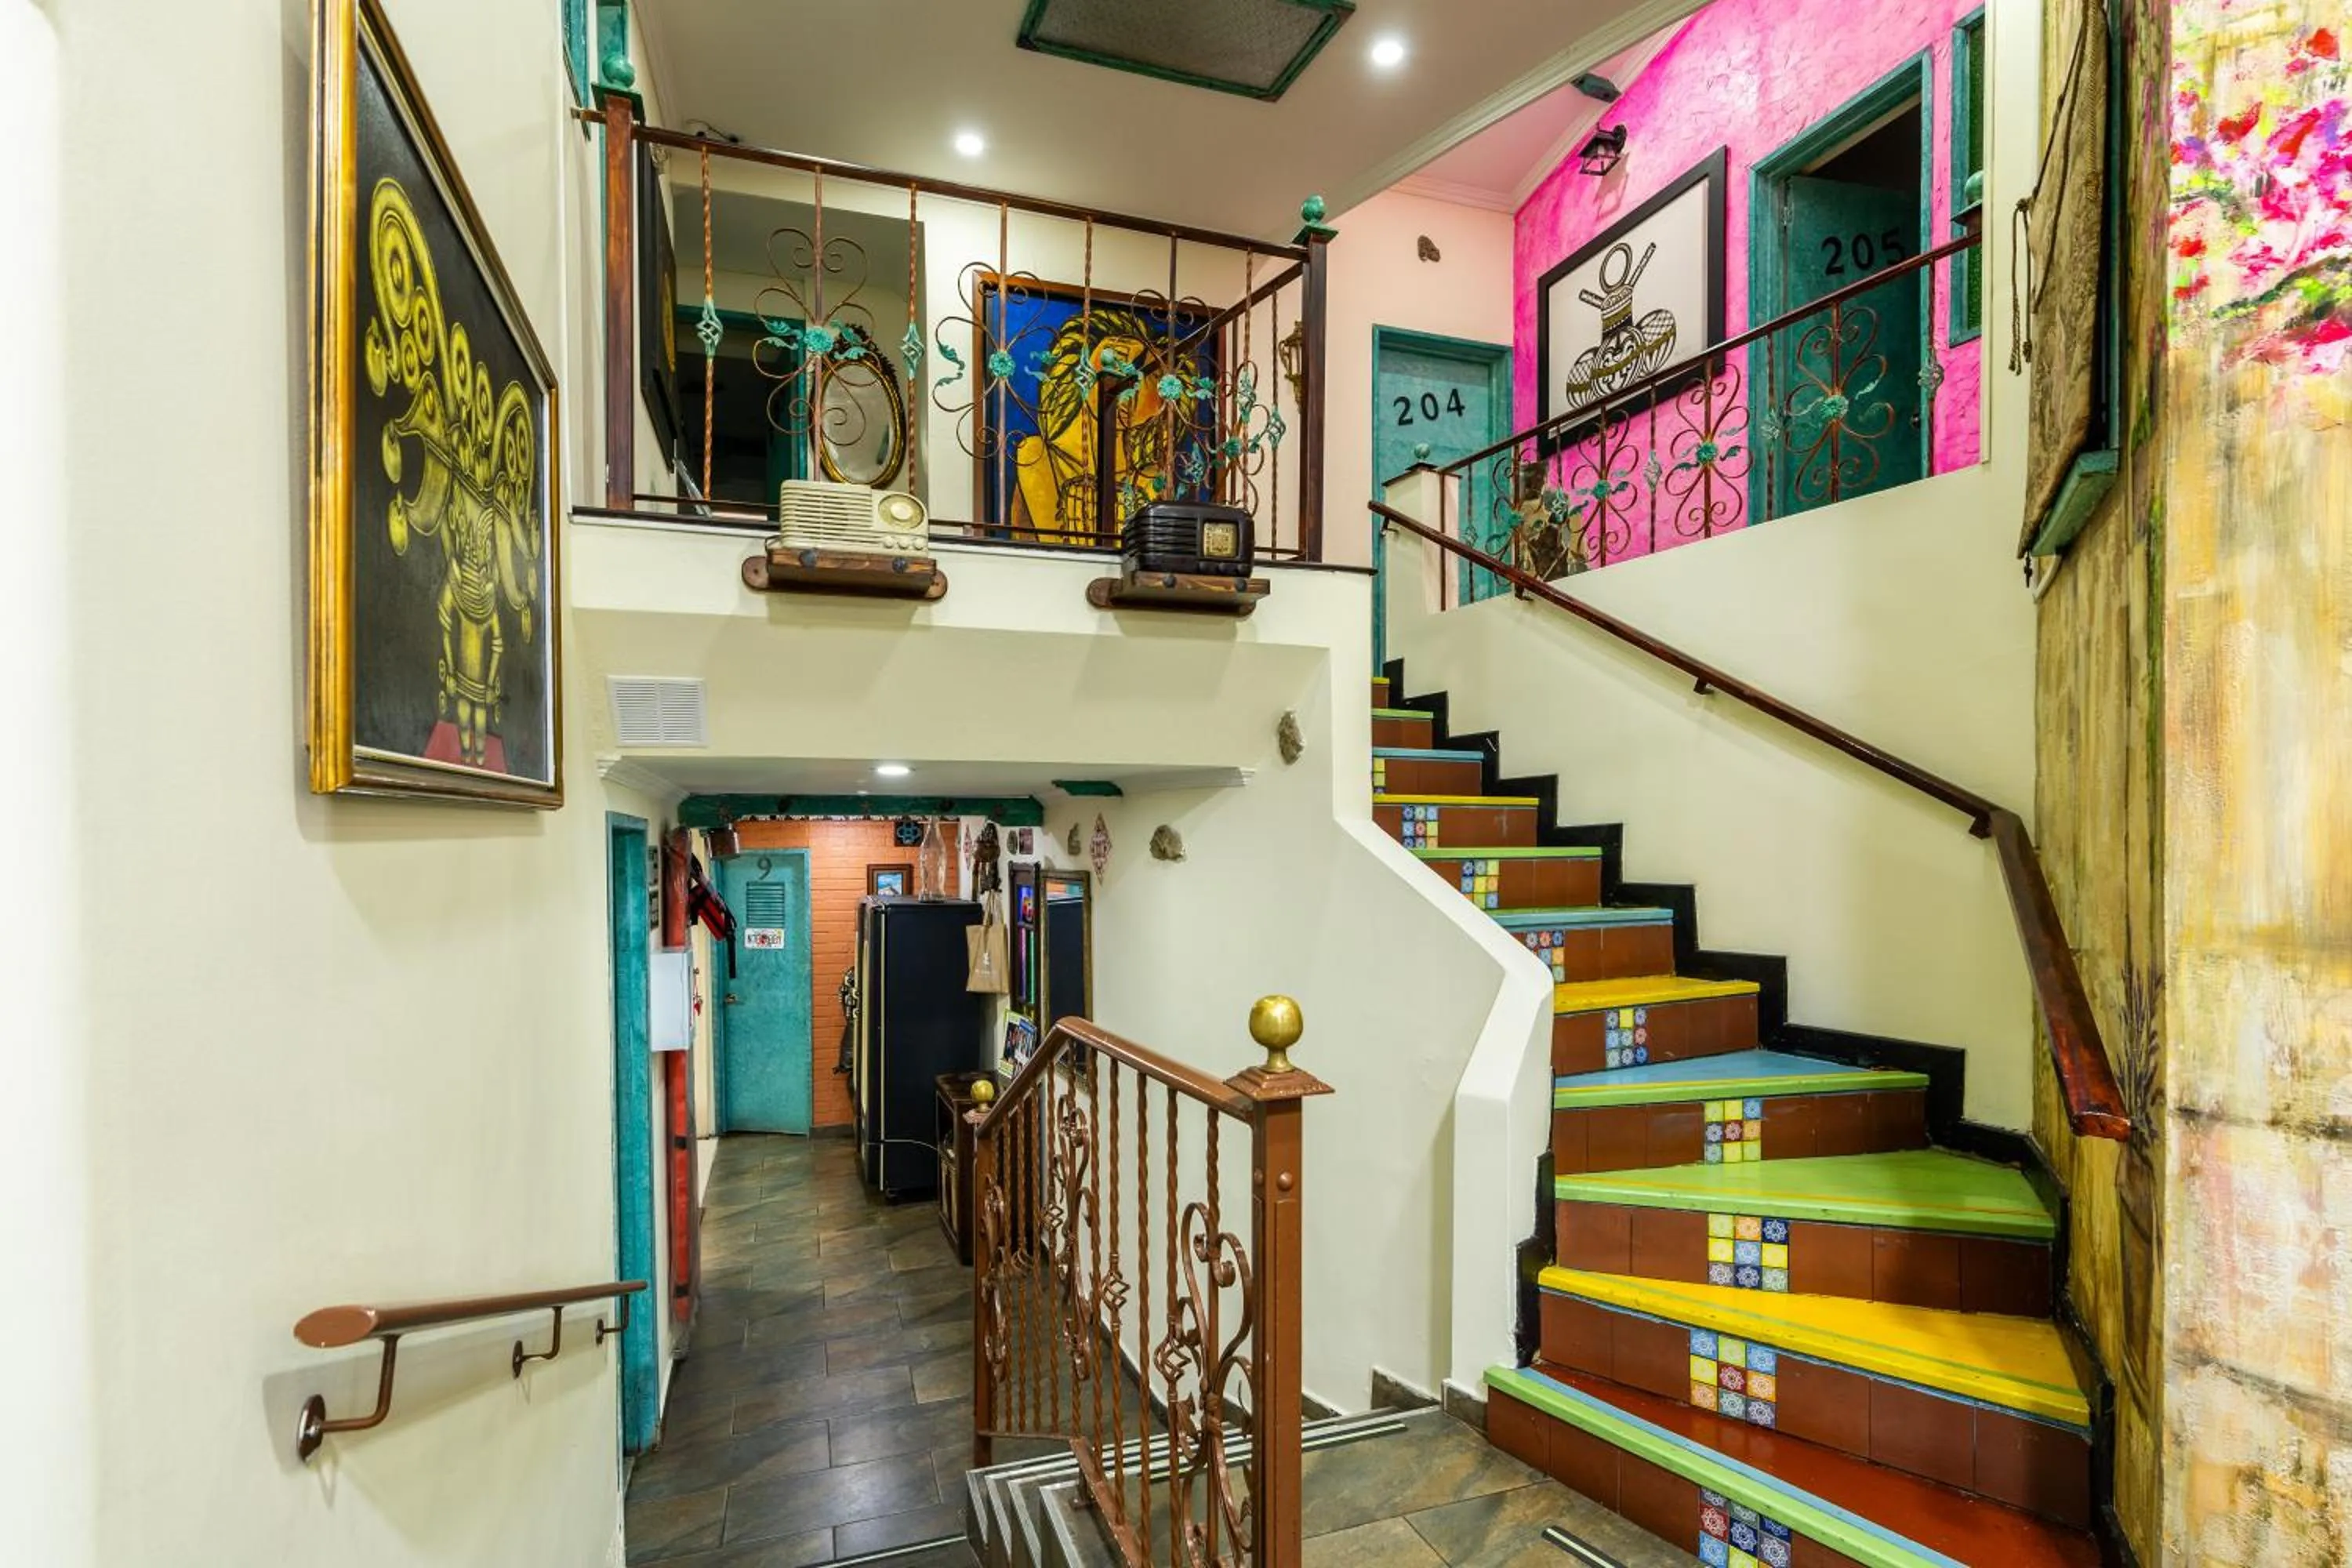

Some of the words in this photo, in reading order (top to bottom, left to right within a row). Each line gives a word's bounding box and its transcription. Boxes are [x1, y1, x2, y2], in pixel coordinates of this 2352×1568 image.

[1820, 227, 1905, 275] 205
[1393, 388, 1465, 426] 204
[757, 856, 772, 880] 9
